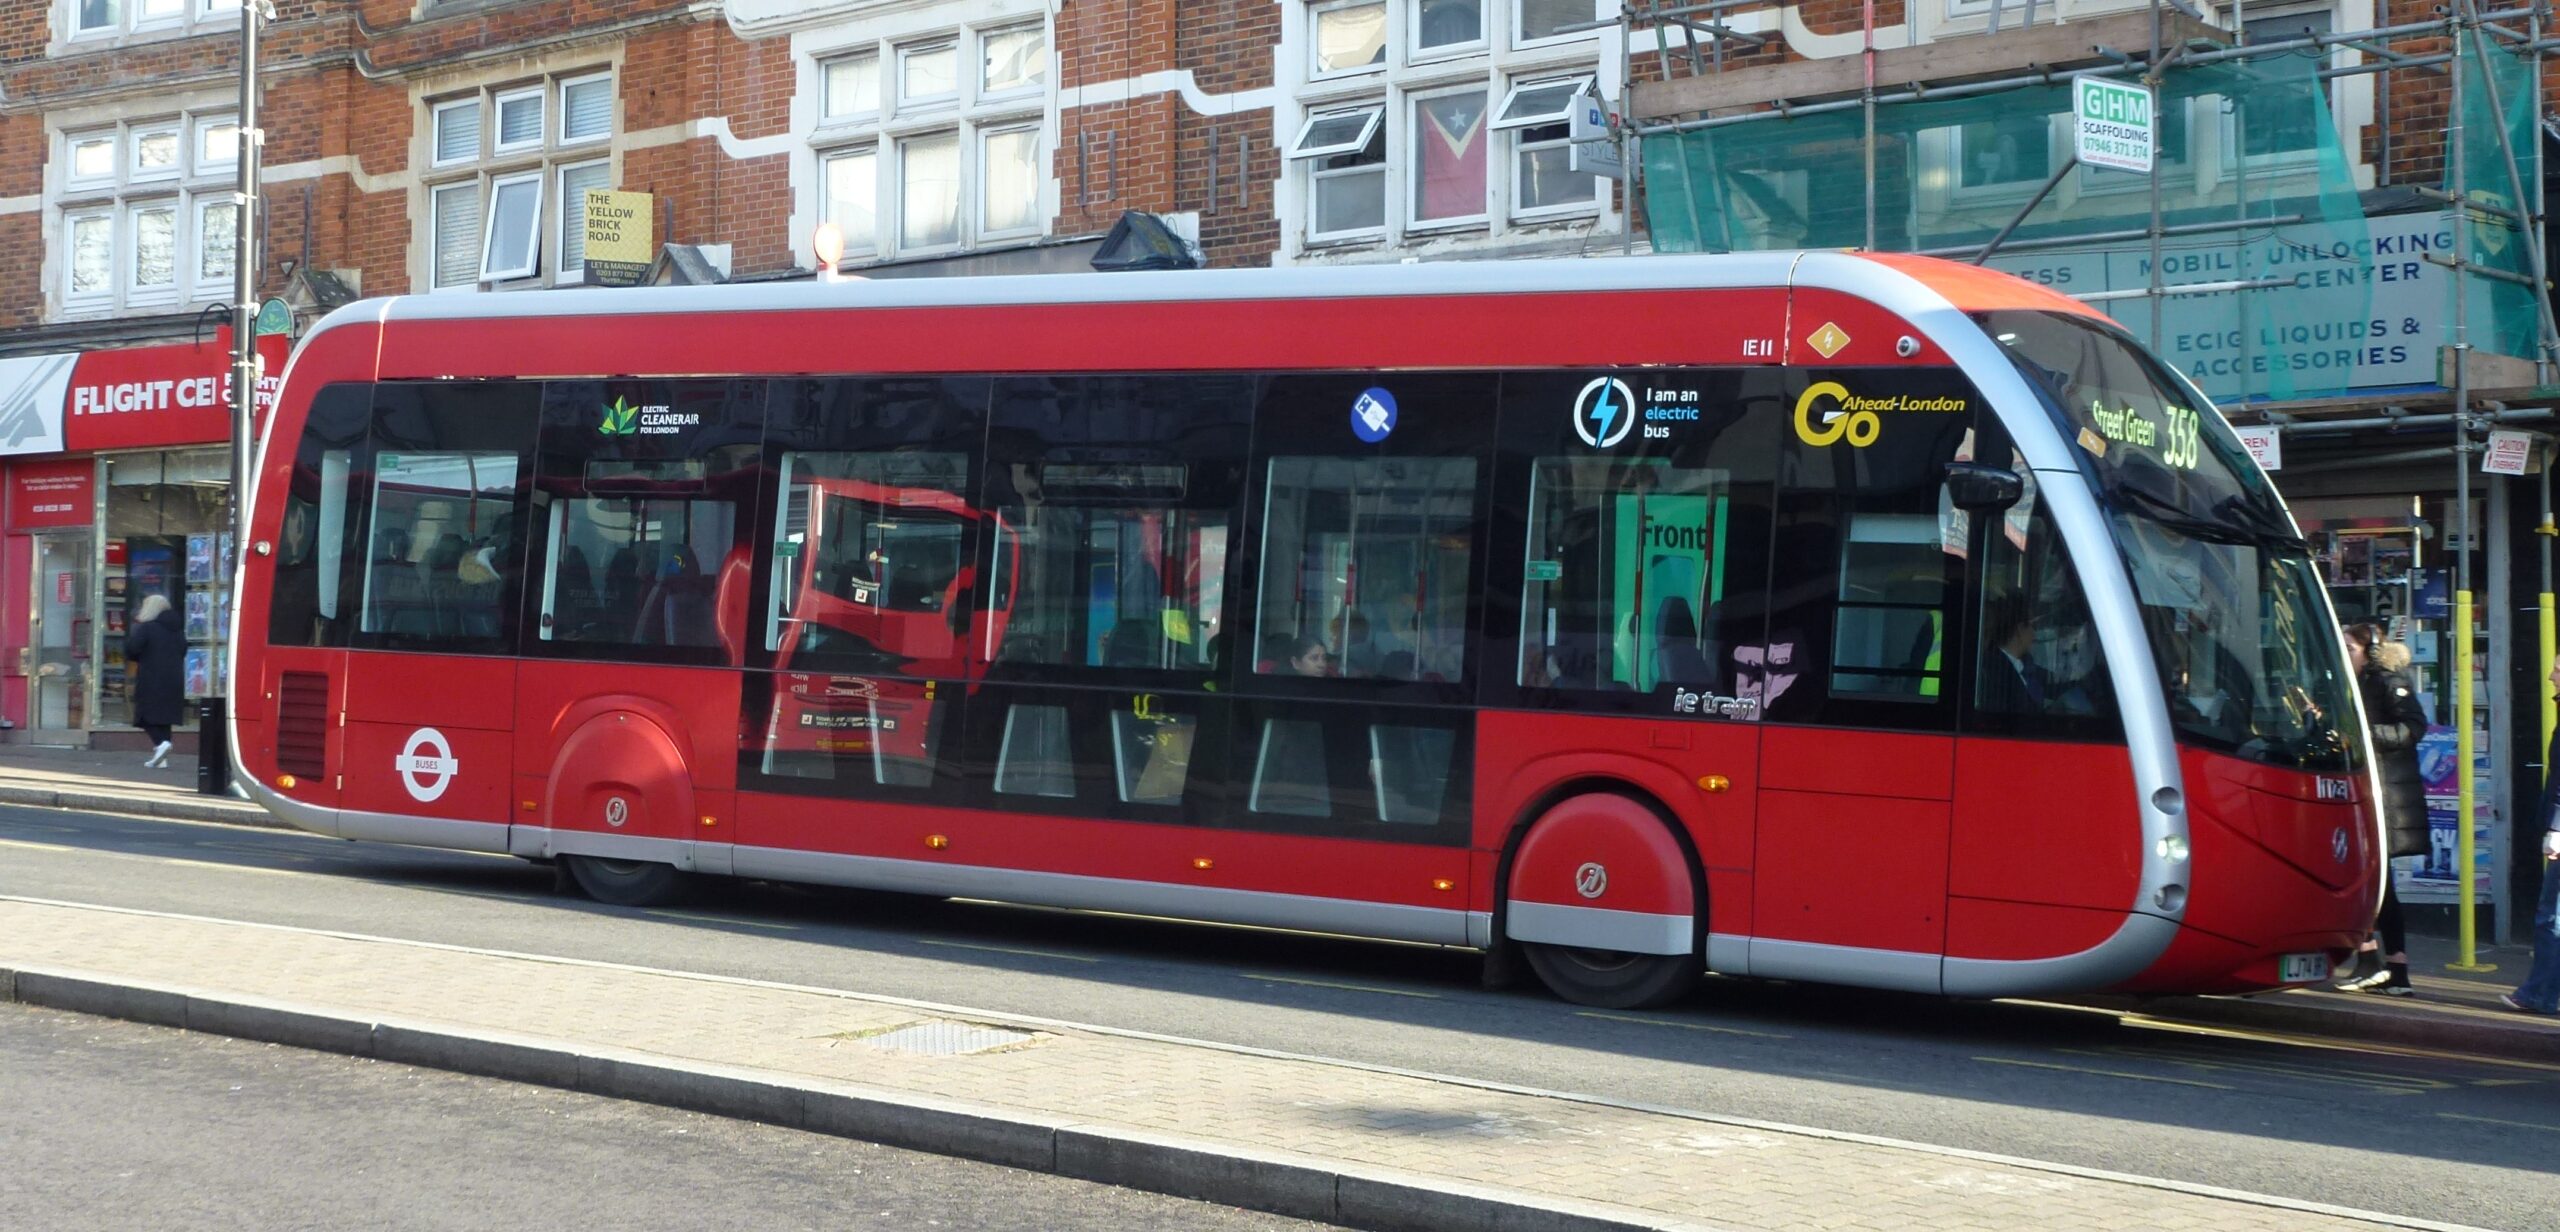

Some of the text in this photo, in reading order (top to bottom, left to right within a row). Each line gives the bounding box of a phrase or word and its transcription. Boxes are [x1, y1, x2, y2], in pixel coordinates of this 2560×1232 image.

[2086, 88, 2147, 123] GHM
[2083, 122, 2148, 142] SCAFFOLDING
[2084, 137, 2148, 159] 07946 371 374
[589, 194, 610, 205] THE
[589, 206, 633, 219] YELLOW
[588, 219, 621, 230] BRICK
[588, 231, 620, 243] ROAD
[2140, 231, 2453, 276] MOBIL UNLOCKING
[591, 261, 602, 269] LET
[610, 262, 646, 271] MANAGED
[2294, 262, 2421, 290] CENTER
[2176, 317, 2421, 352] ECIG LIQUIDS &
[2191, 345, 2408, 378] ACCESSORIES
[74, 377, 216, 416] FLIGHT CE
[1646, 388, 1698, 402] I am an
[1842, 395, 1965, 411] Ahead-London
[642, 405, 669, 413] ELECTRIC
[1645, 406, 1699, 420] electric
[1794, 381, 1880, 447] Go
[640, 426, 680, 434] FOR LONDON
[1644, 424, 1670, 438] bus
[2125, 408, 2155, 447] Green
[2163, 406, 2198, 469] 358
[2244, 437, 2269, 448] REN
[2497, 439, 2527, 451] CAUTION
[1642, 515, 1706, 550] Front
[1674, 687, 1756, 716] ie tram
[415, 760, 438, 769] BUSES
